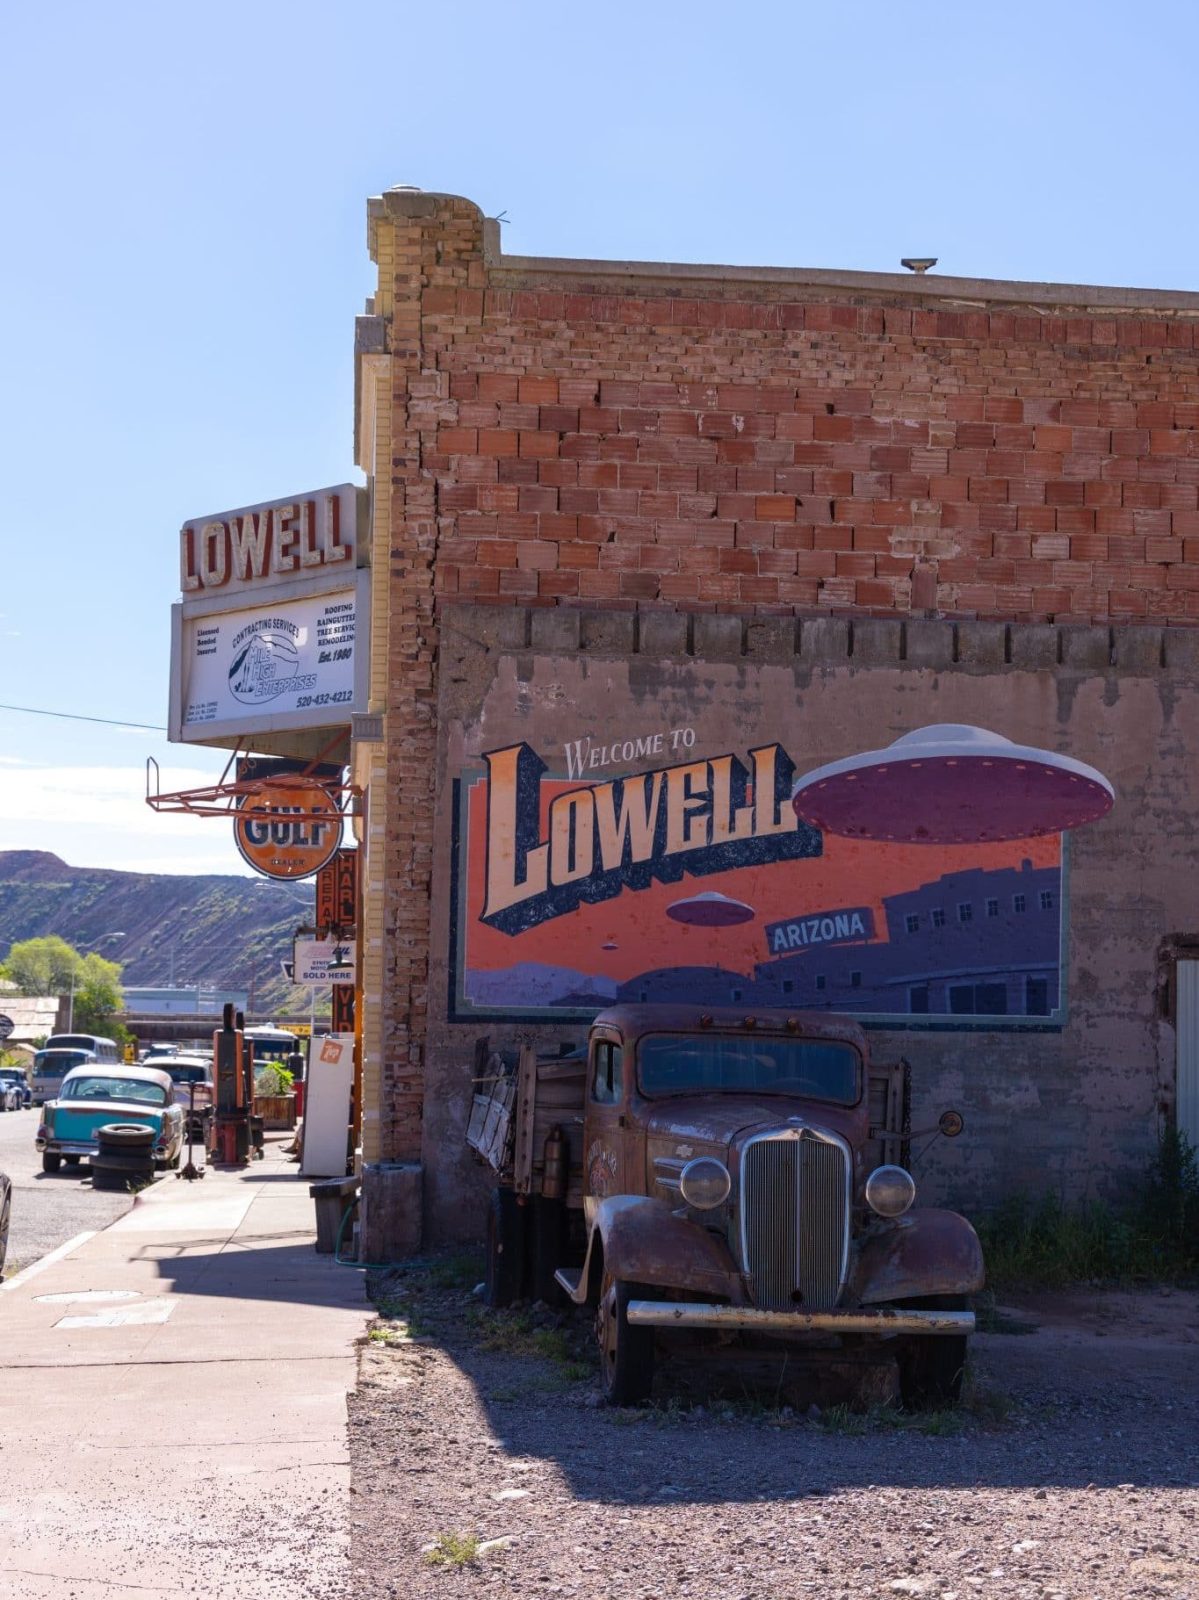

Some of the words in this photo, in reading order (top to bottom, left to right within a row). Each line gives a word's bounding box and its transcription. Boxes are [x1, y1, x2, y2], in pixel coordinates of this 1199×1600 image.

[181, 495, 352, 592] LOWELL
[324, 603, 353, 615] ROOFING
[232, 618, 272, 648] CONTRACTING
[272, 618, 299, 638] SERVICES
[317, 627, 333, 637] TREE
[333, 623, 356, 634] SERVIC
[318, 634, 356, 646] REMODELIN
[250, 645, 271, 665] MILE
[251, 662, 277, 682] HIGH
[254, 674, 318, 698] ENTERPRISES
[296, 690, 353, 708] 520-432-4212
[563, 736, 664, 782] WELCOME
[670, 728, 696, 750] TO
[245, 806, 331, 848] GULF
[480, 741, 810, 926] LOWELL
[773, 911, 865, 951] ARIZONA
[303, 972, 326, 980] SOLD
[328, 972, 352, 980] HERE
